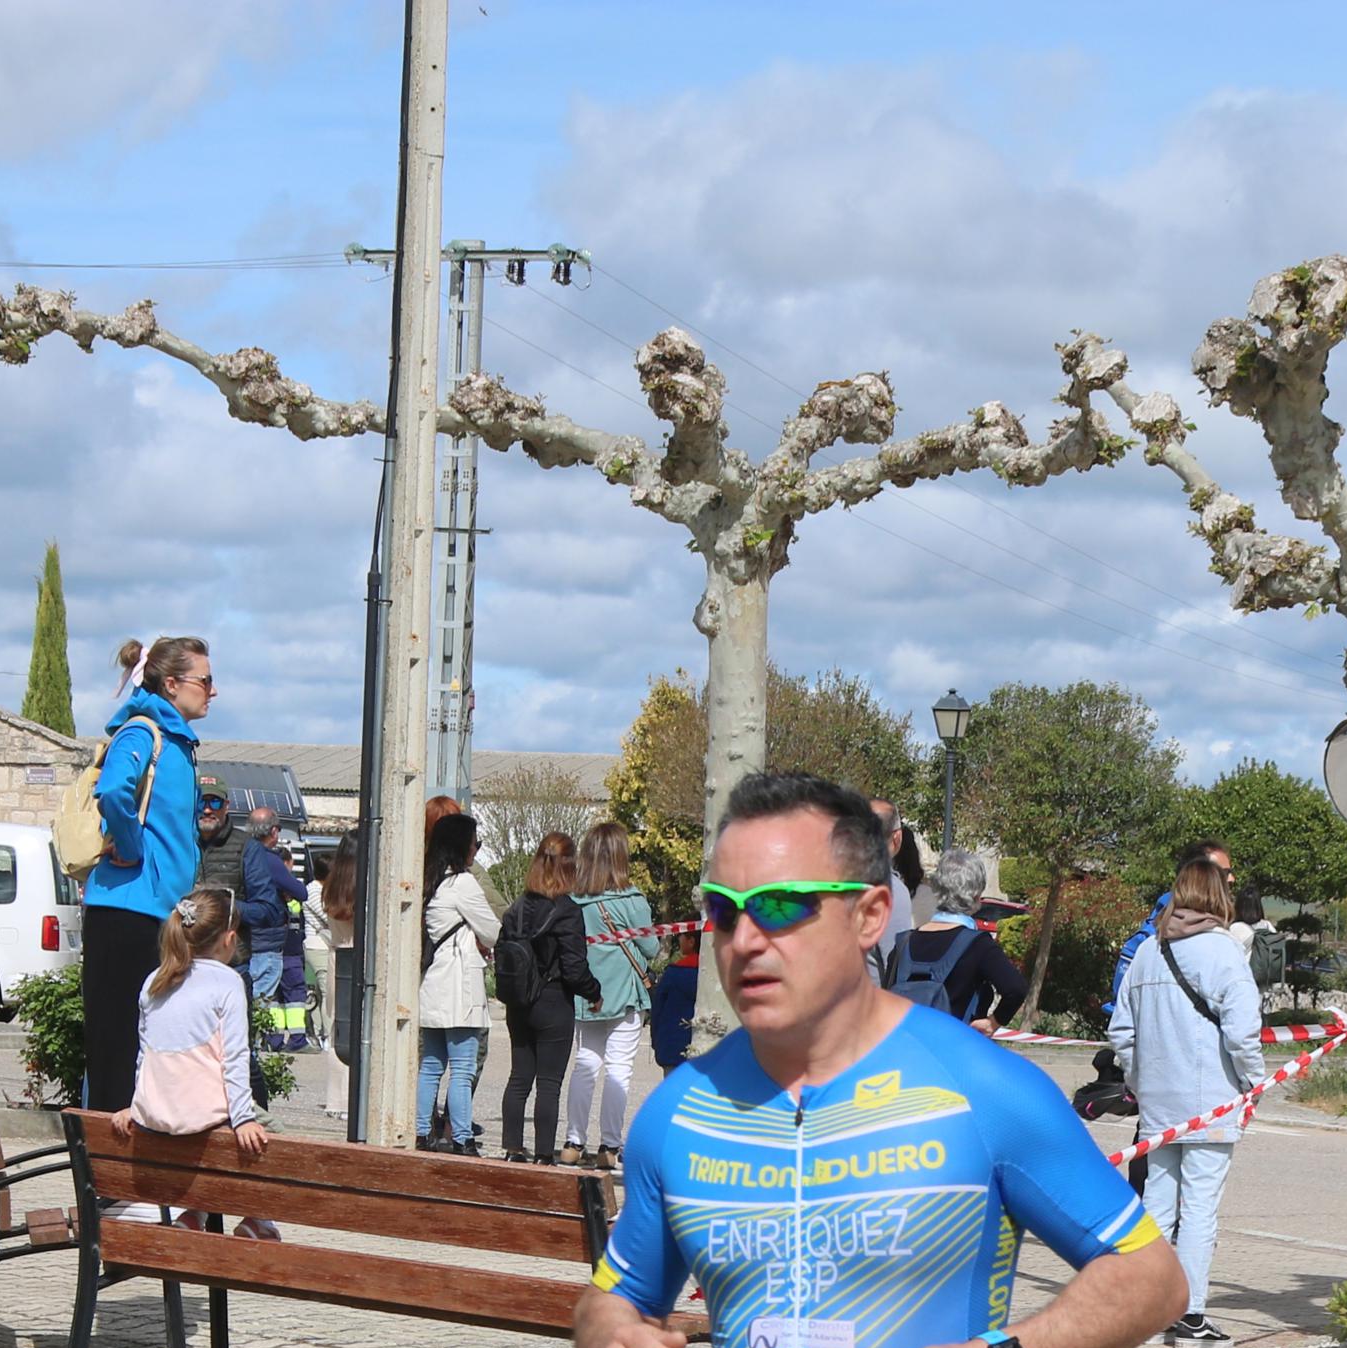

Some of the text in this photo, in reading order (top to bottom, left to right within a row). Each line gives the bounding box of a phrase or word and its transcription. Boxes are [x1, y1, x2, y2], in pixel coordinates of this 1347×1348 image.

[688, 1140, 946, 1188] TRIATLON DUERO
[708, 1209, 913, 1263] ENRIQUEZ
[765, 1261, 839, 1303] ESP
